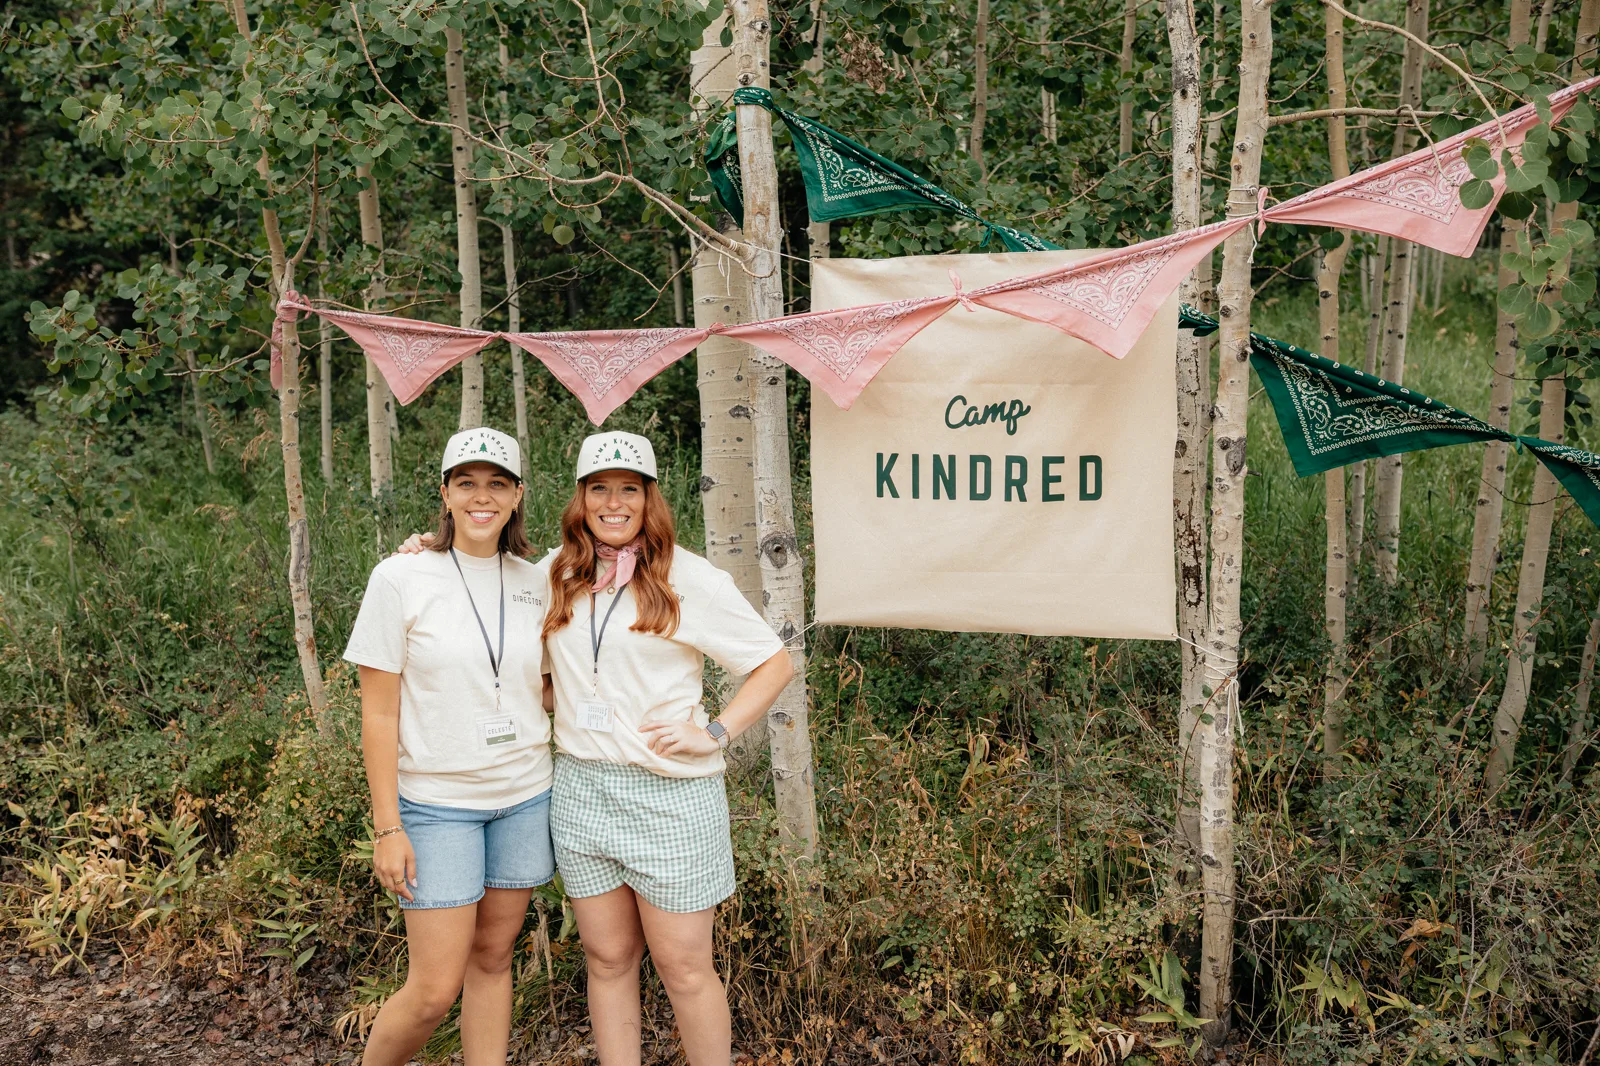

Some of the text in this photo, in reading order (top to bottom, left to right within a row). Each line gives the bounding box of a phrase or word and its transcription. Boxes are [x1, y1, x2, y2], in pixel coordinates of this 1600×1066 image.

[945, 394, 1031, 436] Camp
[458, 433, 508, 462] CAMP KINDRED
[592, 438, 643, 466] CAMP KINDRED
[876, 452, 1103, 502] KINDRED
[512, 594, 542, 606] DIRECTOR
[487, 725, 512, 735] CELESTE
